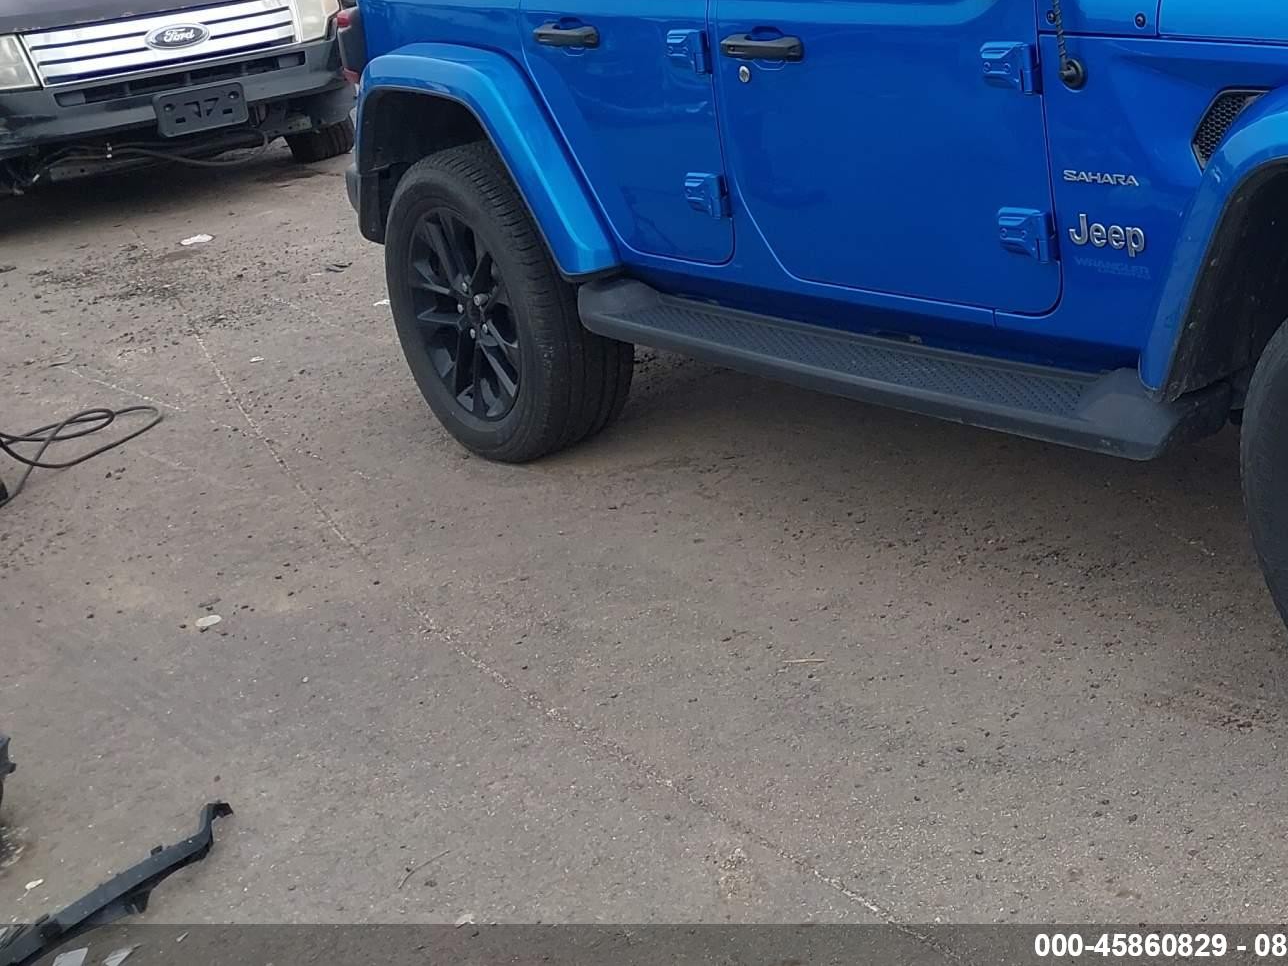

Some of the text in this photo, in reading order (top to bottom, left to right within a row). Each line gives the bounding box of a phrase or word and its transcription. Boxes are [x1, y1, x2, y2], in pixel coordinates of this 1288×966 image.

[163, 27, 196, 43] Ford
[1063, 169, 1139, 186] SAHARA
[1068, 213, 1145, 257] Jeep
